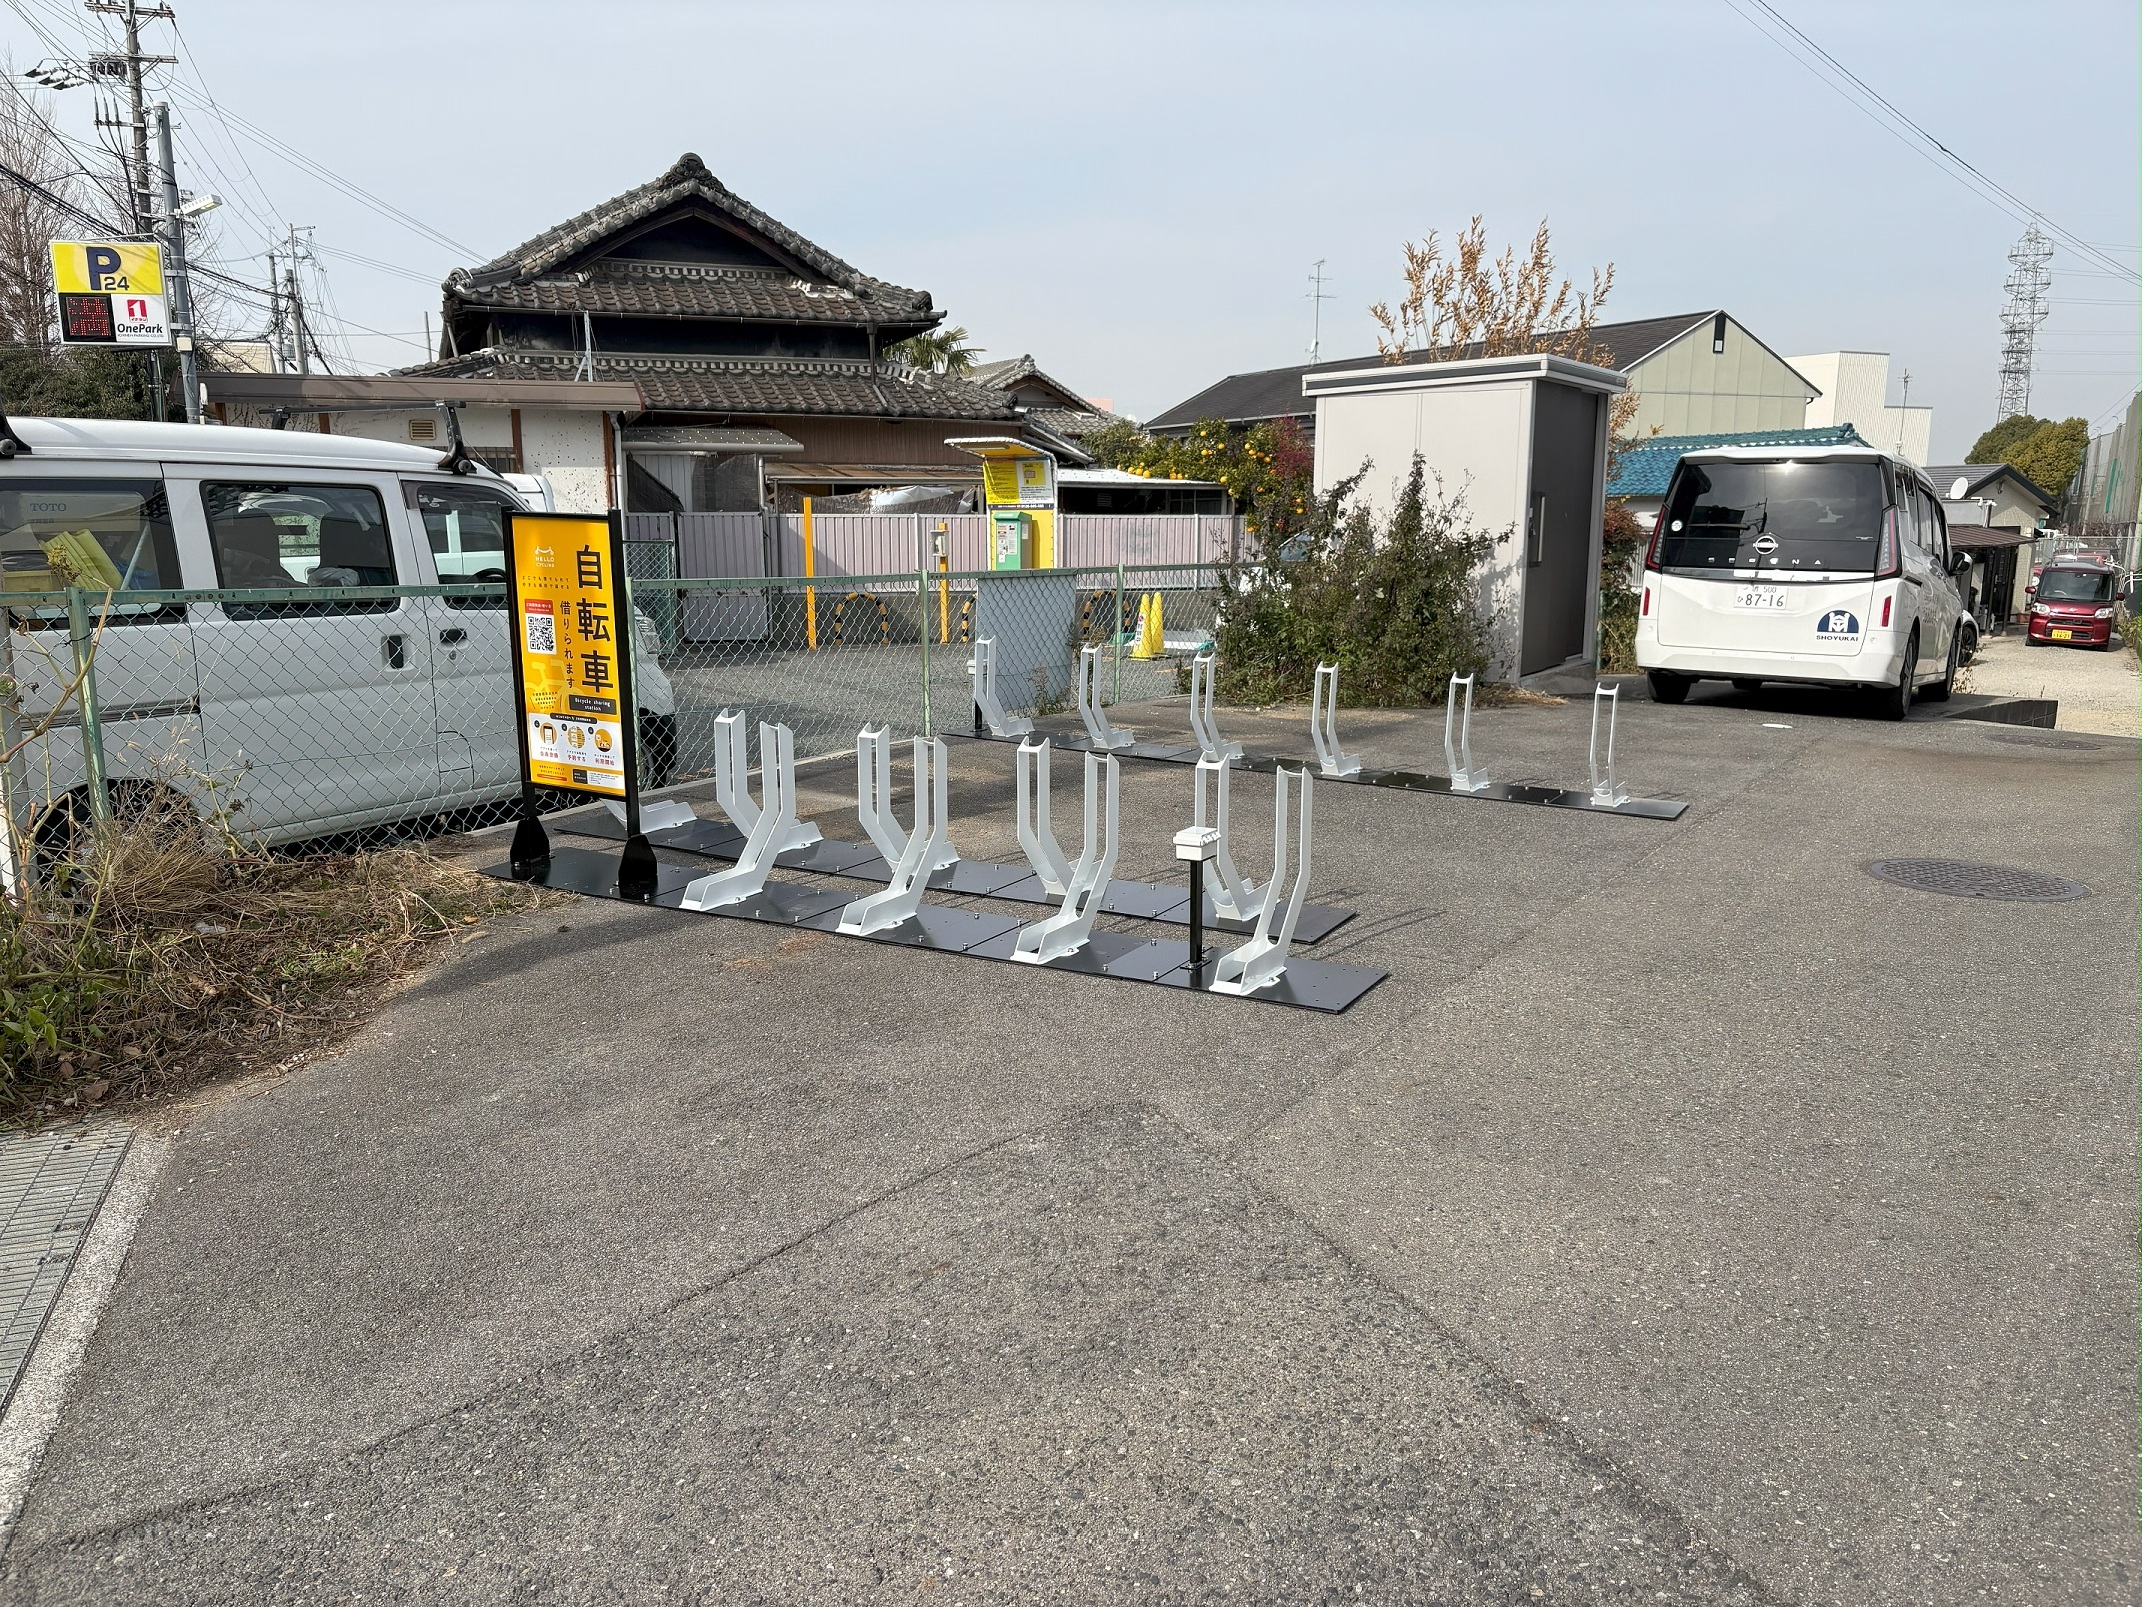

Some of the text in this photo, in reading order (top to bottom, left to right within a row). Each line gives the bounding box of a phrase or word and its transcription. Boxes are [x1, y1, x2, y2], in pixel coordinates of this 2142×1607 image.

[86, 247, 130, 291] P 24
[117, 323, 163, 334] OnePark
[30, 503, 67, 512] TOTO
[1763, 585, 1777, 593] 500
[1745, 593, 1784, 607] 87-16
[576, 544, 614, 693] 自転車
[560, 600, 575, 688] 借りられます
[574, 697, 611, 708] Bicycle sharing
